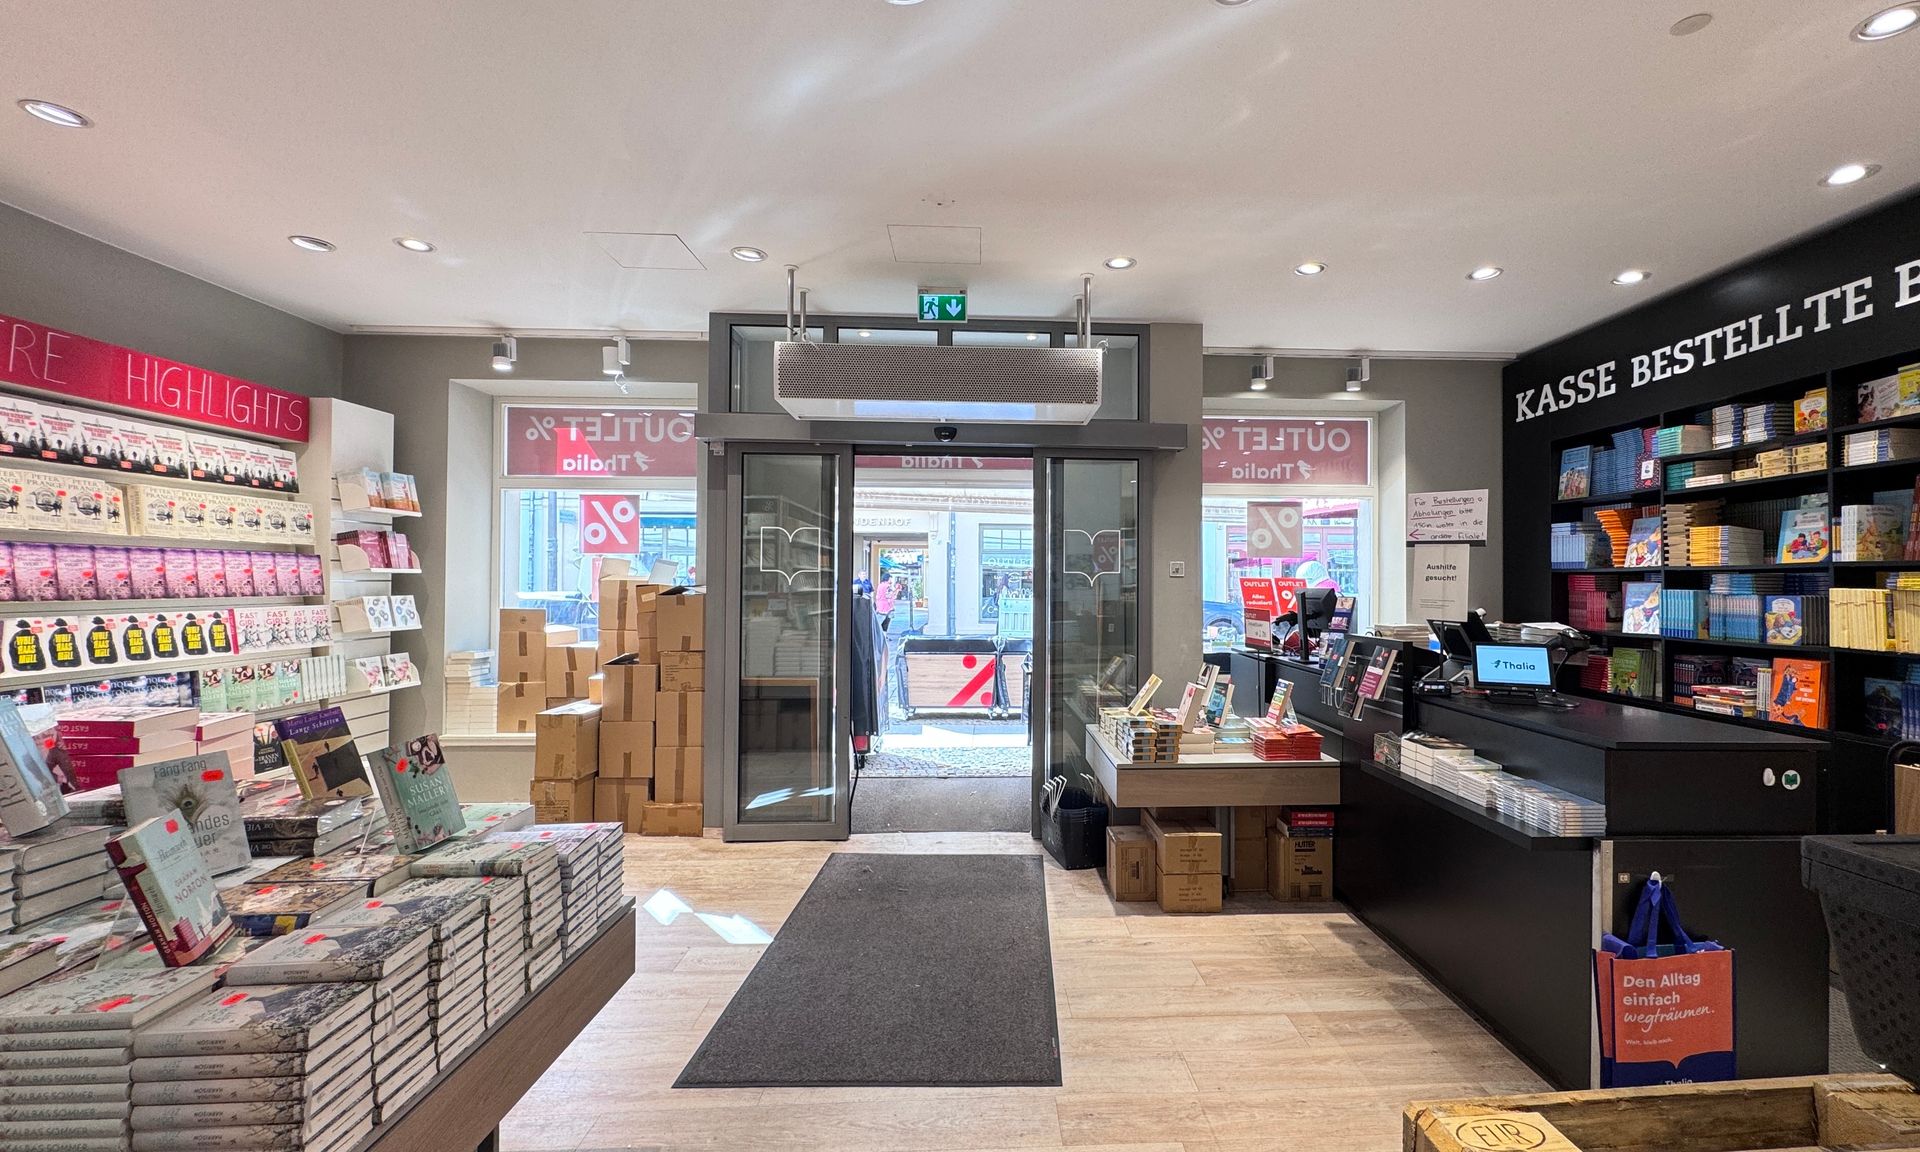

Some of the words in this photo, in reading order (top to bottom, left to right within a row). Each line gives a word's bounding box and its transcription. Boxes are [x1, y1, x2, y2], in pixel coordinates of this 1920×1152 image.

[1516, 360, 1617, 423] KASSE
[1631, 275, 1873, 388] BESTELLTE
[127, 353, 303, 432] HIGHLIGHTS
[1414, 496, 1426, 507] Für
[1433, 495, 1475, 505] Bestellungen
[1412, 510, 1454, 519] Abholungen
[266, 610, 287, 618] FAST
[1502, 661, 1536, 670] Thalia
[110, 680, 134, 688] nora
[146, 676, 166, 684] nora
[72, 684, 96, 693] nora
[290, 726, 310, 736] Lange
[312, 718, 339, 729] Schatten
[154, 764, 180, 779] Fang
[181, 759, 206, 774] Fang
[409, 776, 443, 796] SUSAN
[407, 784, 449, 808] MALLERY
[174, 868, 198, 888] GRAHAM
[174, 874, 209, 904] NORTON
[142, 902, 158, 932] NORTON
[154, 931, 170, 954] GRAHAM
[1623, 975, 1656, 988] Den
[1660, 973, 1701, 986] Alltag
[1623, 992, 1680, 1006] einfach
[56, 1019, 100, 1029] SOMMER
[1624, 1005, 1716, 1032] wegträumen.
[52, 1038, 96, 1046] SOMMER
[46, 1056, 90, 1065] SOMMER
[55, 1074, 98, 1082] SOMMER
[52, 1091, 94, 1100] SOMMER
[52, 1110, 96, 1118] SOMMER
[50, 1128, 88, 1136] SOMMER
[1470, 1122, 1534, 1146] EUR
